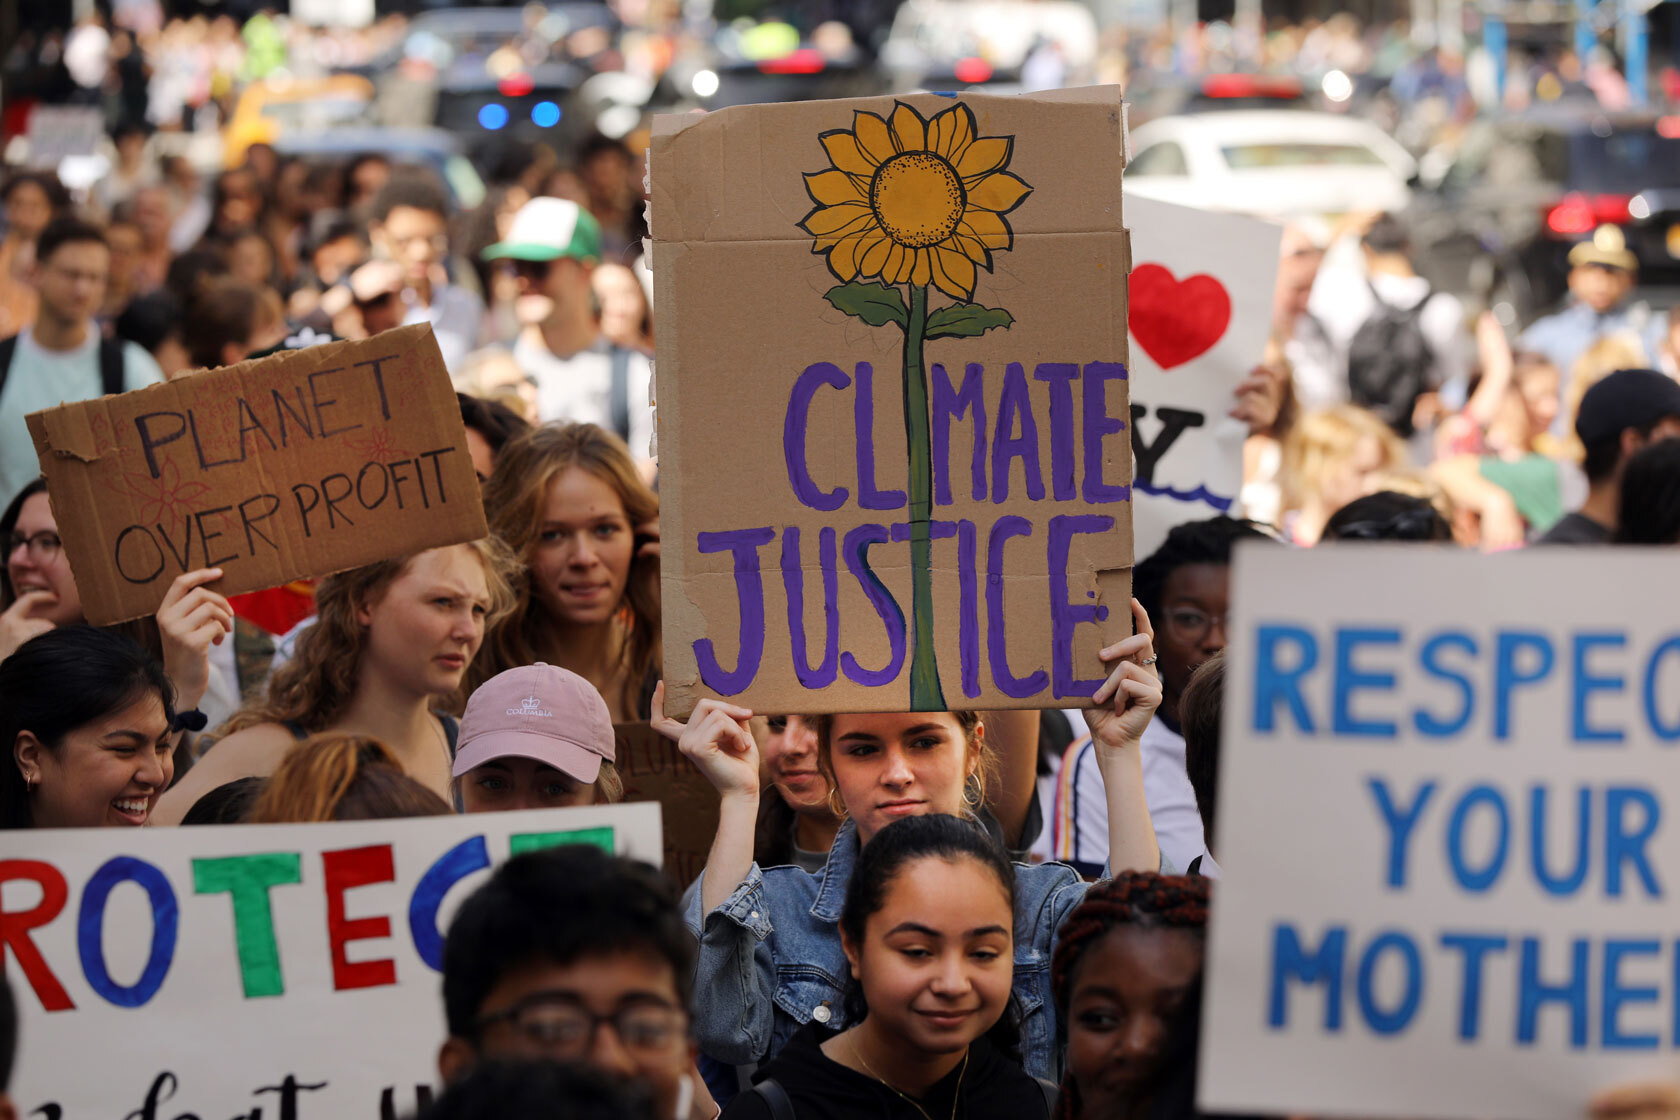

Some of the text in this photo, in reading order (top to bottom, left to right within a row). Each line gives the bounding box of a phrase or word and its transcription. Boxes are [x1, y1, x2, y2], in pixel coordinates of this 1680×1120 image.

[134, 354, 400, 479] PLANET
[115, 447, 455, 584] OVER PROFIT
[692, 514, 1115, 699] JUSTICE
[1366, 776, 1664, 898] YOUR
[1266, 922, 1680, 1050] MOTHE
